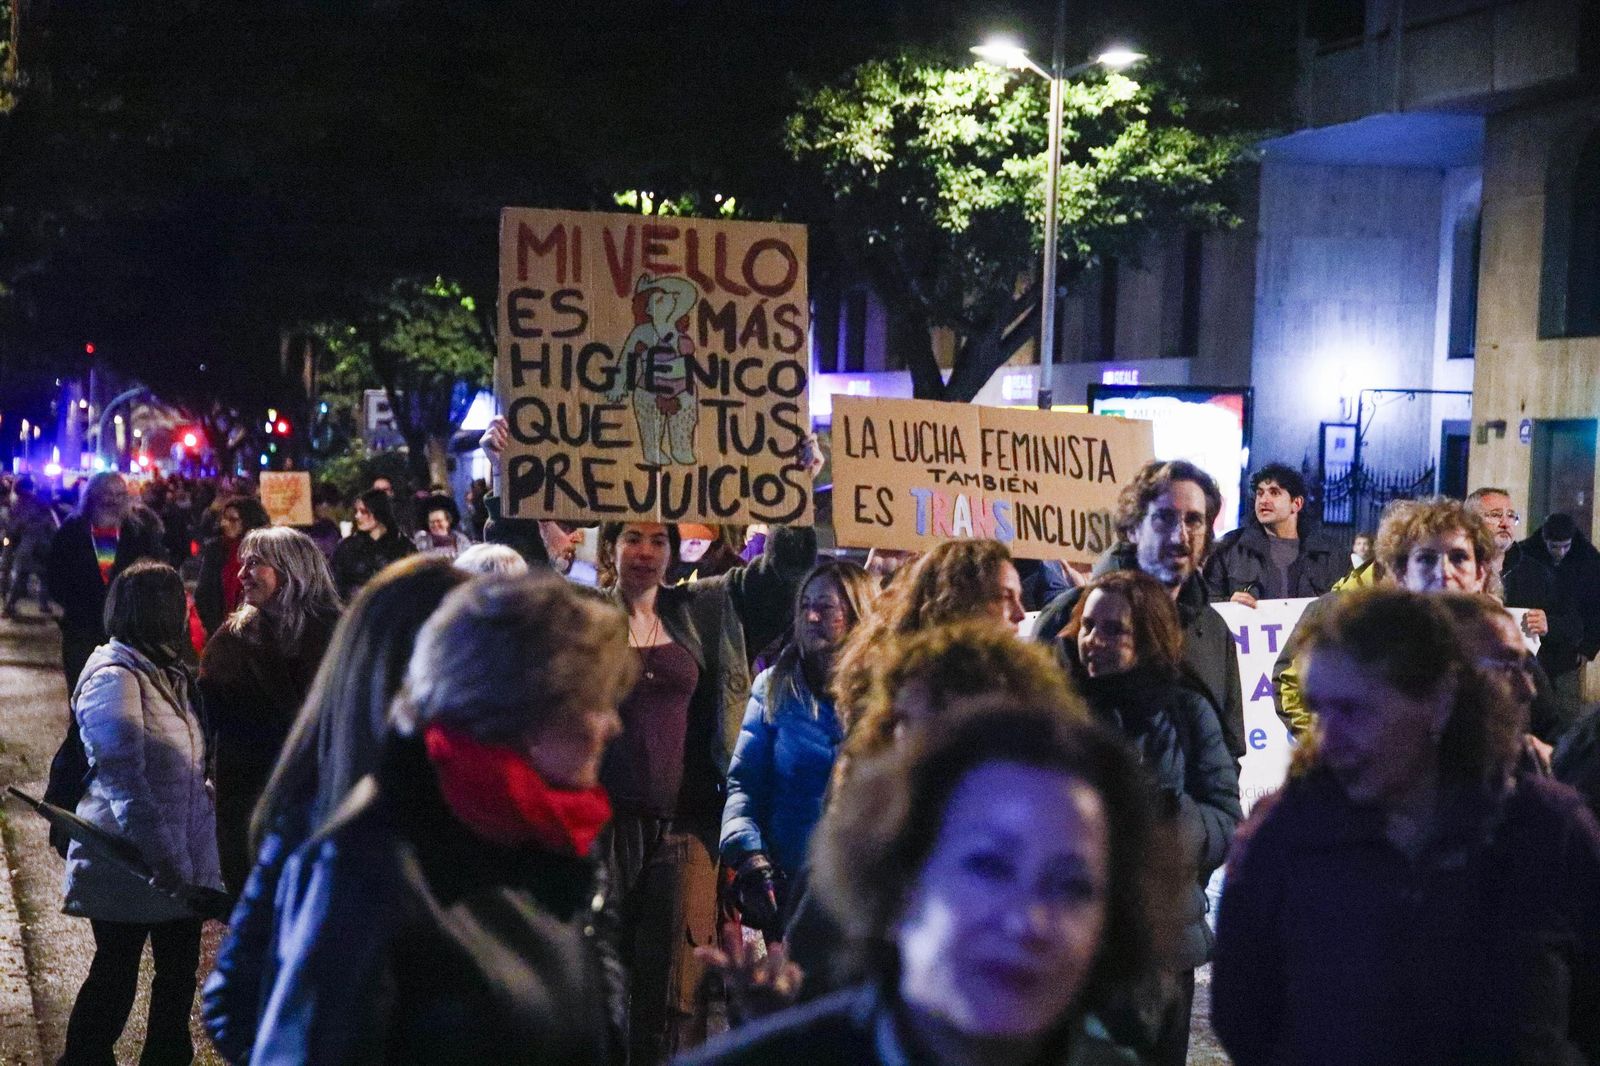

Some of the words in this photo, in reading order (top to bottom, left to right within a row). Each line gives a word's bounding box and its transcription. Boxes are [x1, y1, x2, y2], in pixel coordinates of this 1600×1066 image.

[517, 222, 582, 284] MI
[602, 223, 799, 299] VELLO
[507, 287, 589, 338] ES
[698, 298, 803, 354] MÁS
[508, 396, 634, 448] QUE
[700, 399, 806, 459] TUS
[843, 415, 880, 460] LA
[888, 419, 968, 465] LUCHA
[980, 428, 1117, 484] FEMINISTA
[508, 453, 807, 523] PREJUICIOS
[926, 468, 1039, 495] TAMBIÉN
[854, 485, 895, 528] ES
[910, 487, 1015, 541] TRANS
[1015, 502, 1112, 553] INCLUSI
